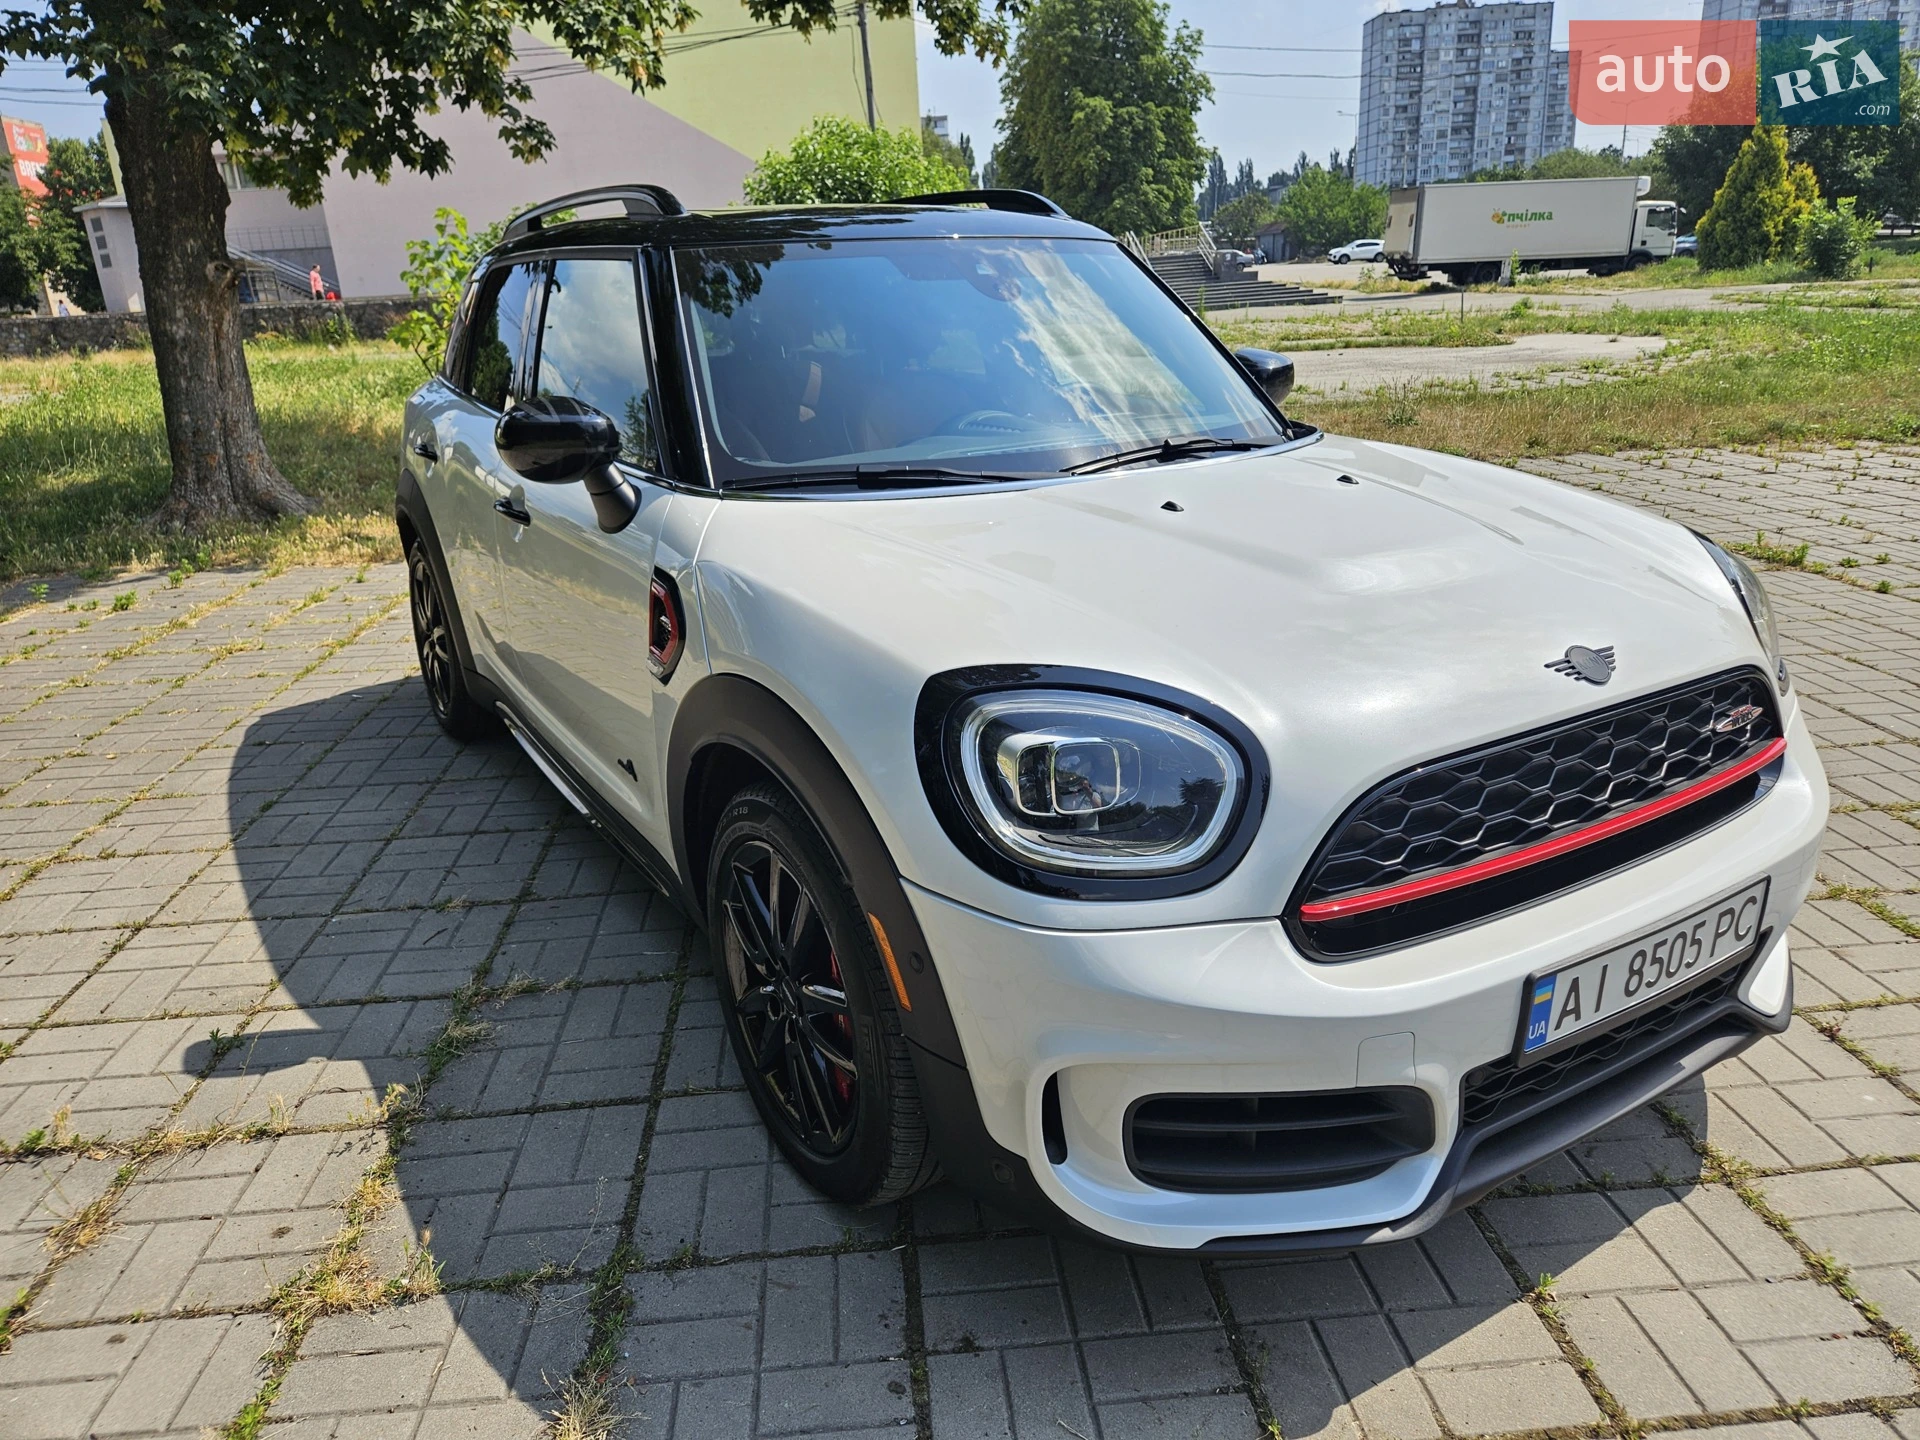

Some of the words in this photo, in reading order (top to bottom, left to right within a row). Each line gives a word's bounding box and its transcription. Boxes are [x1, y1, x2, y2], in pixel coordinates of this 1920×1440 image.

[1507, 209, 1553, 223] пчілка
[1553, 963, 1609, 1031] AI
[1623, 919, 1707, 998] 8505
[1709, 895, 1758, 957] PC
[1527, 1021, 1546, 1041] UA
